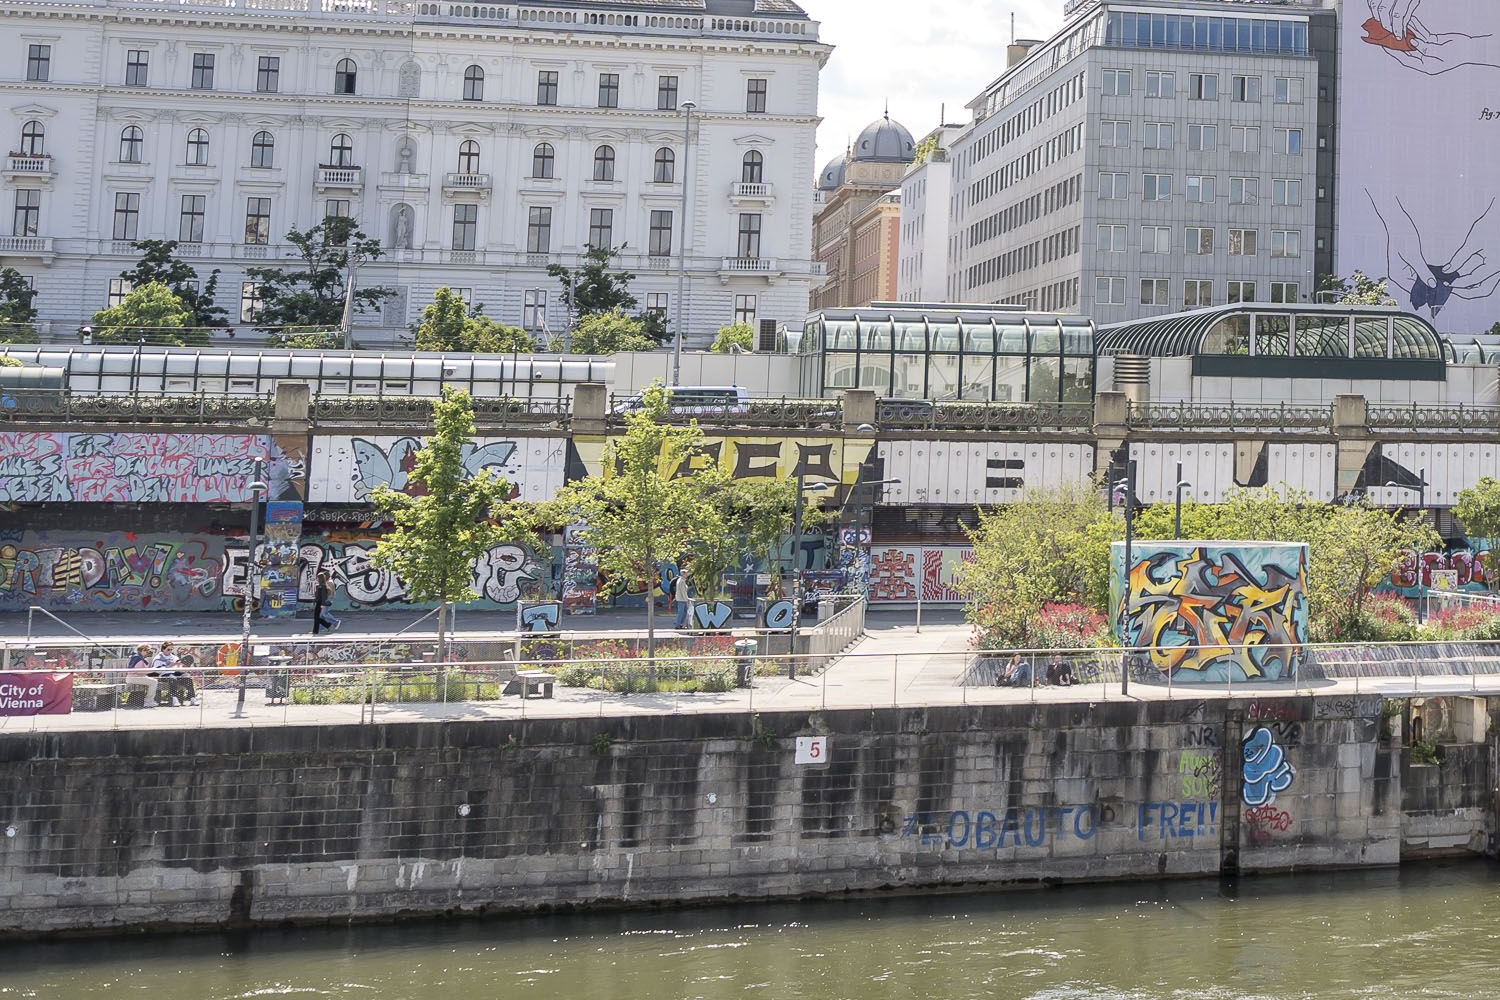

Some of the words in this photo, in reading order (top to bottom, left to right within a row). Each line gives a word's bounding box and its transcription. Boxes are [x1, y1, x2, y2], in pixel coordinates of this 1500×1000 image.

[0, 684, 26, 699] City
[29, 684, 43, 696] of
[0, 698, 44, 709] Vienna
[810, 742, 820, 758] 5
[1137, 801, 1218, 842] FREI!
